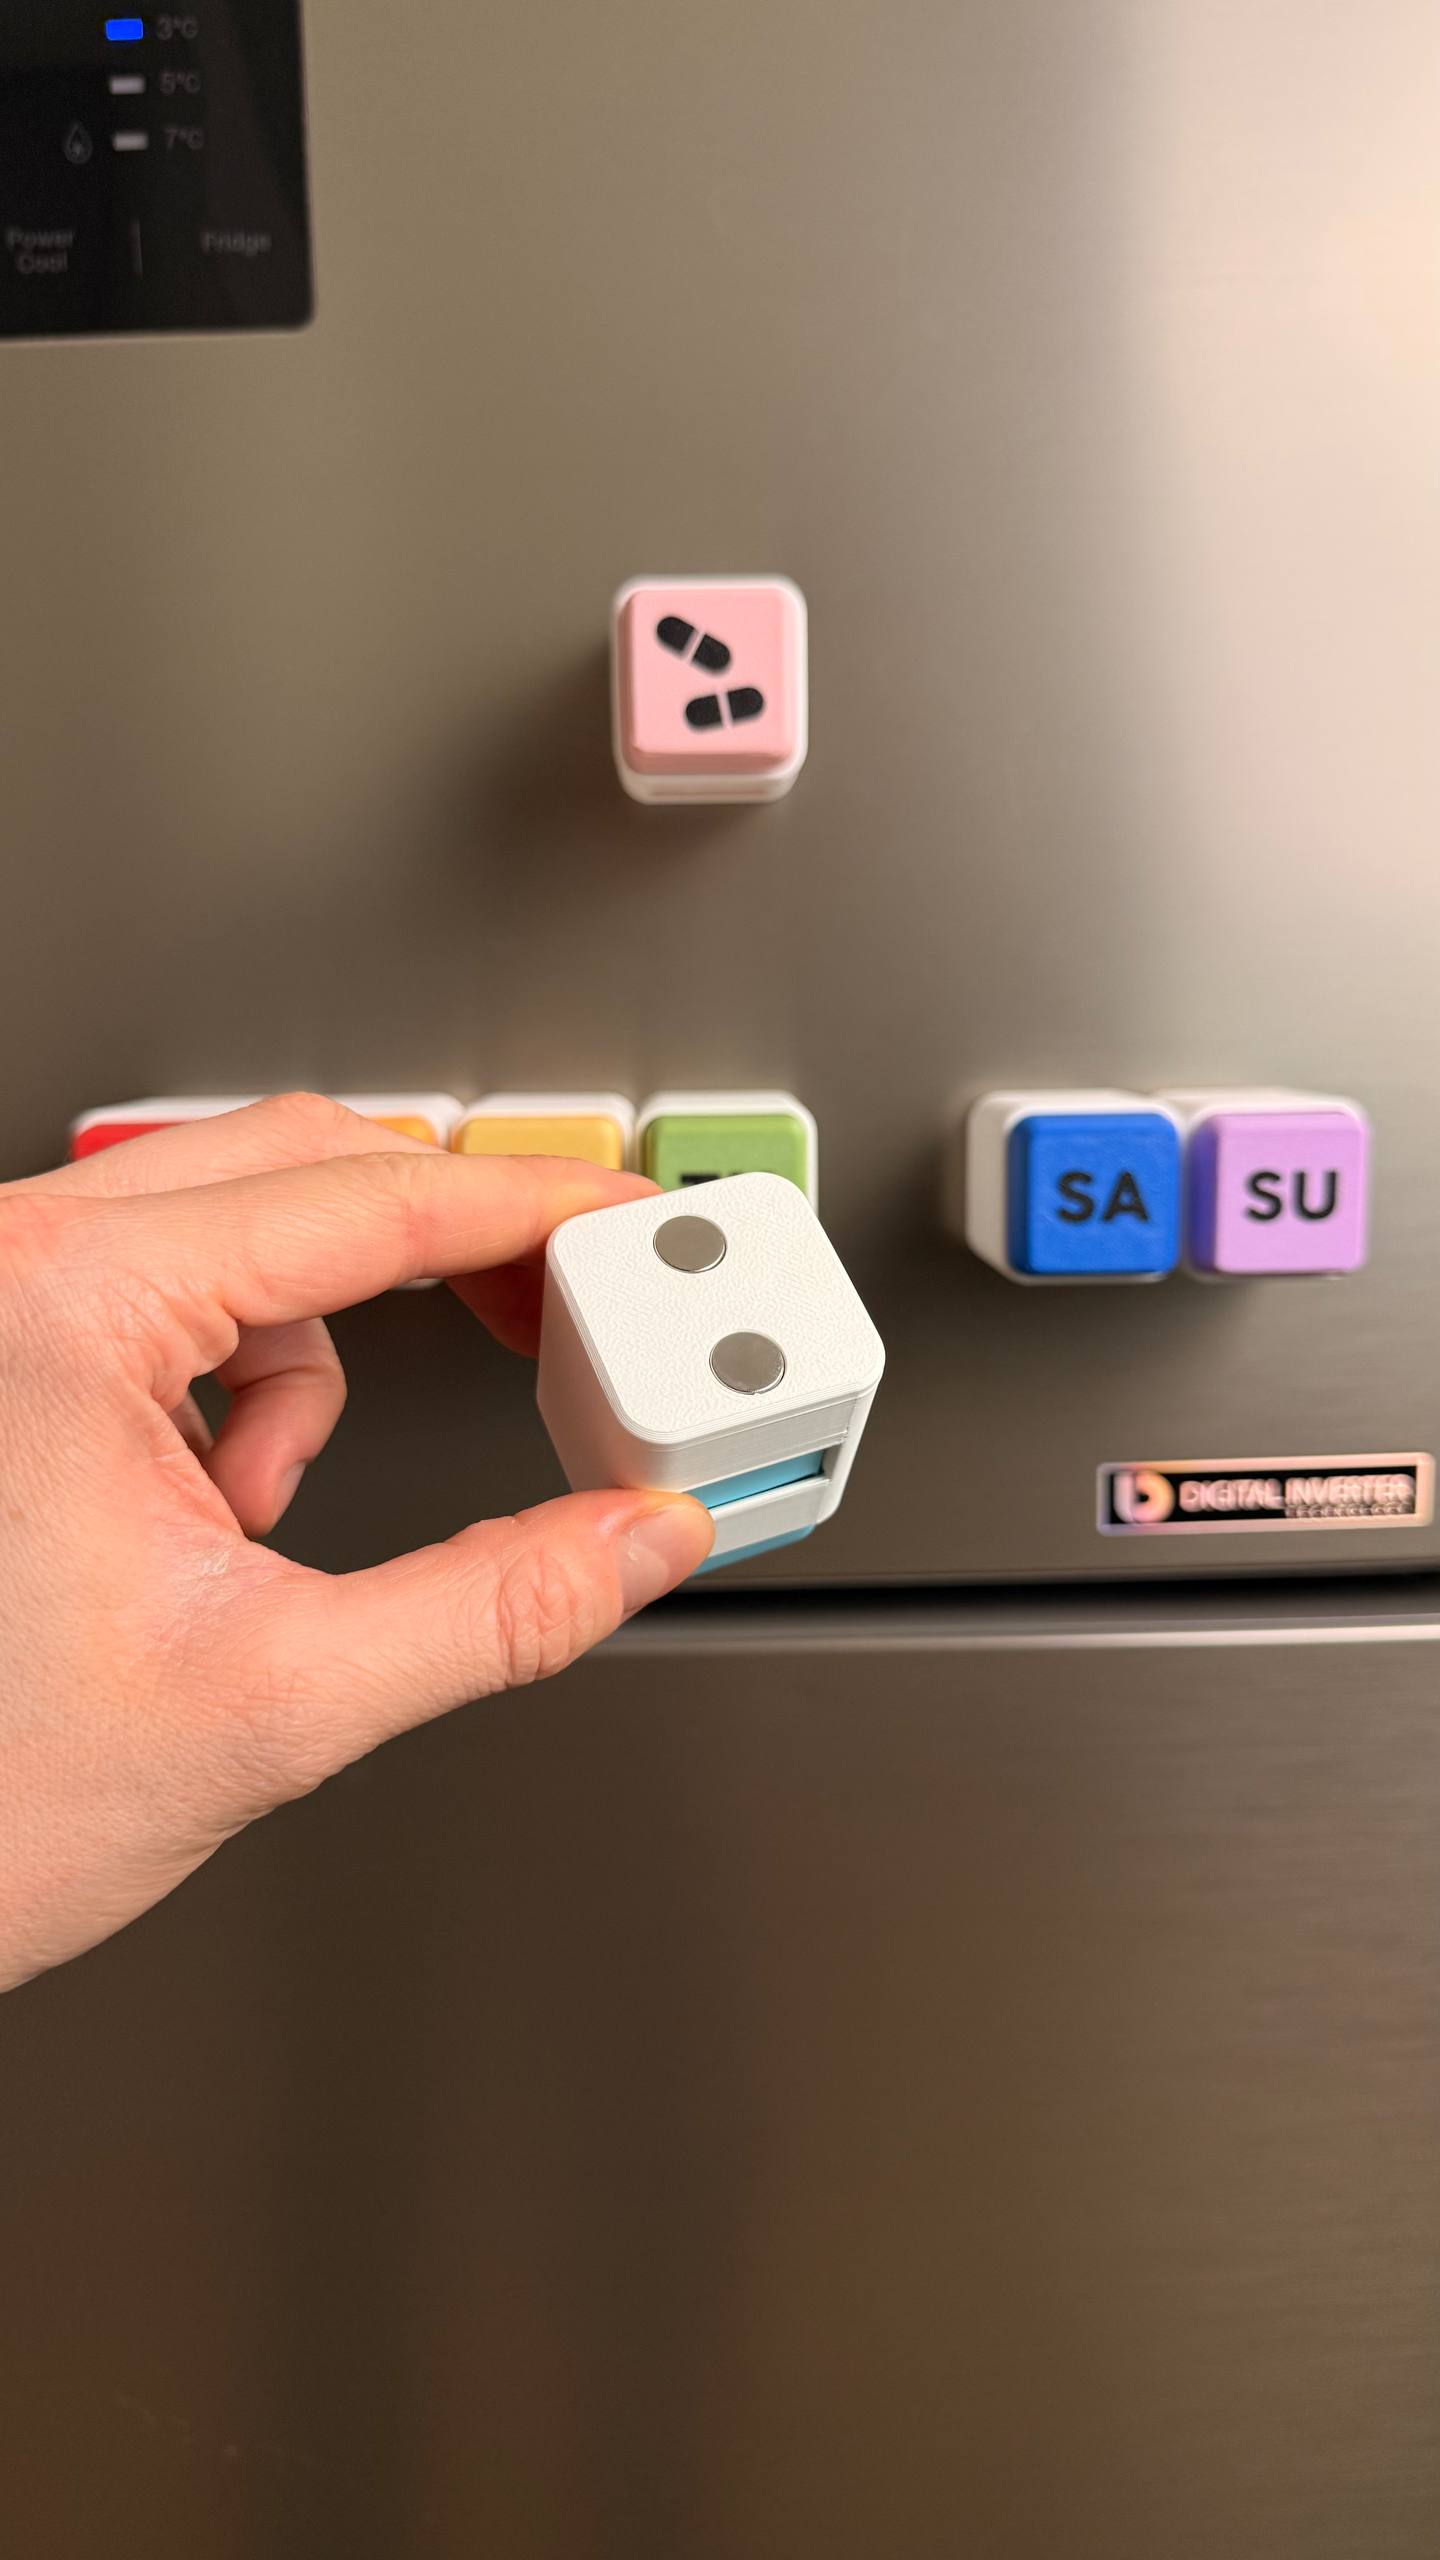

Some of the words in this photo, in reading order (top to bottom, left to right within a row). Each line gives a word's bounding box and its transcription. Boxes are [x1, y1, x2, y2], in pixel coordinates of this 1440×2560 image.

[1057, 1171, 1149, 1223] SA
[1245, 1170, 1339, 1221] SU
[1179, 1478, 1283, 1511] DIGITAL
[1285, 1474, 1415, 1505] INVERTER
